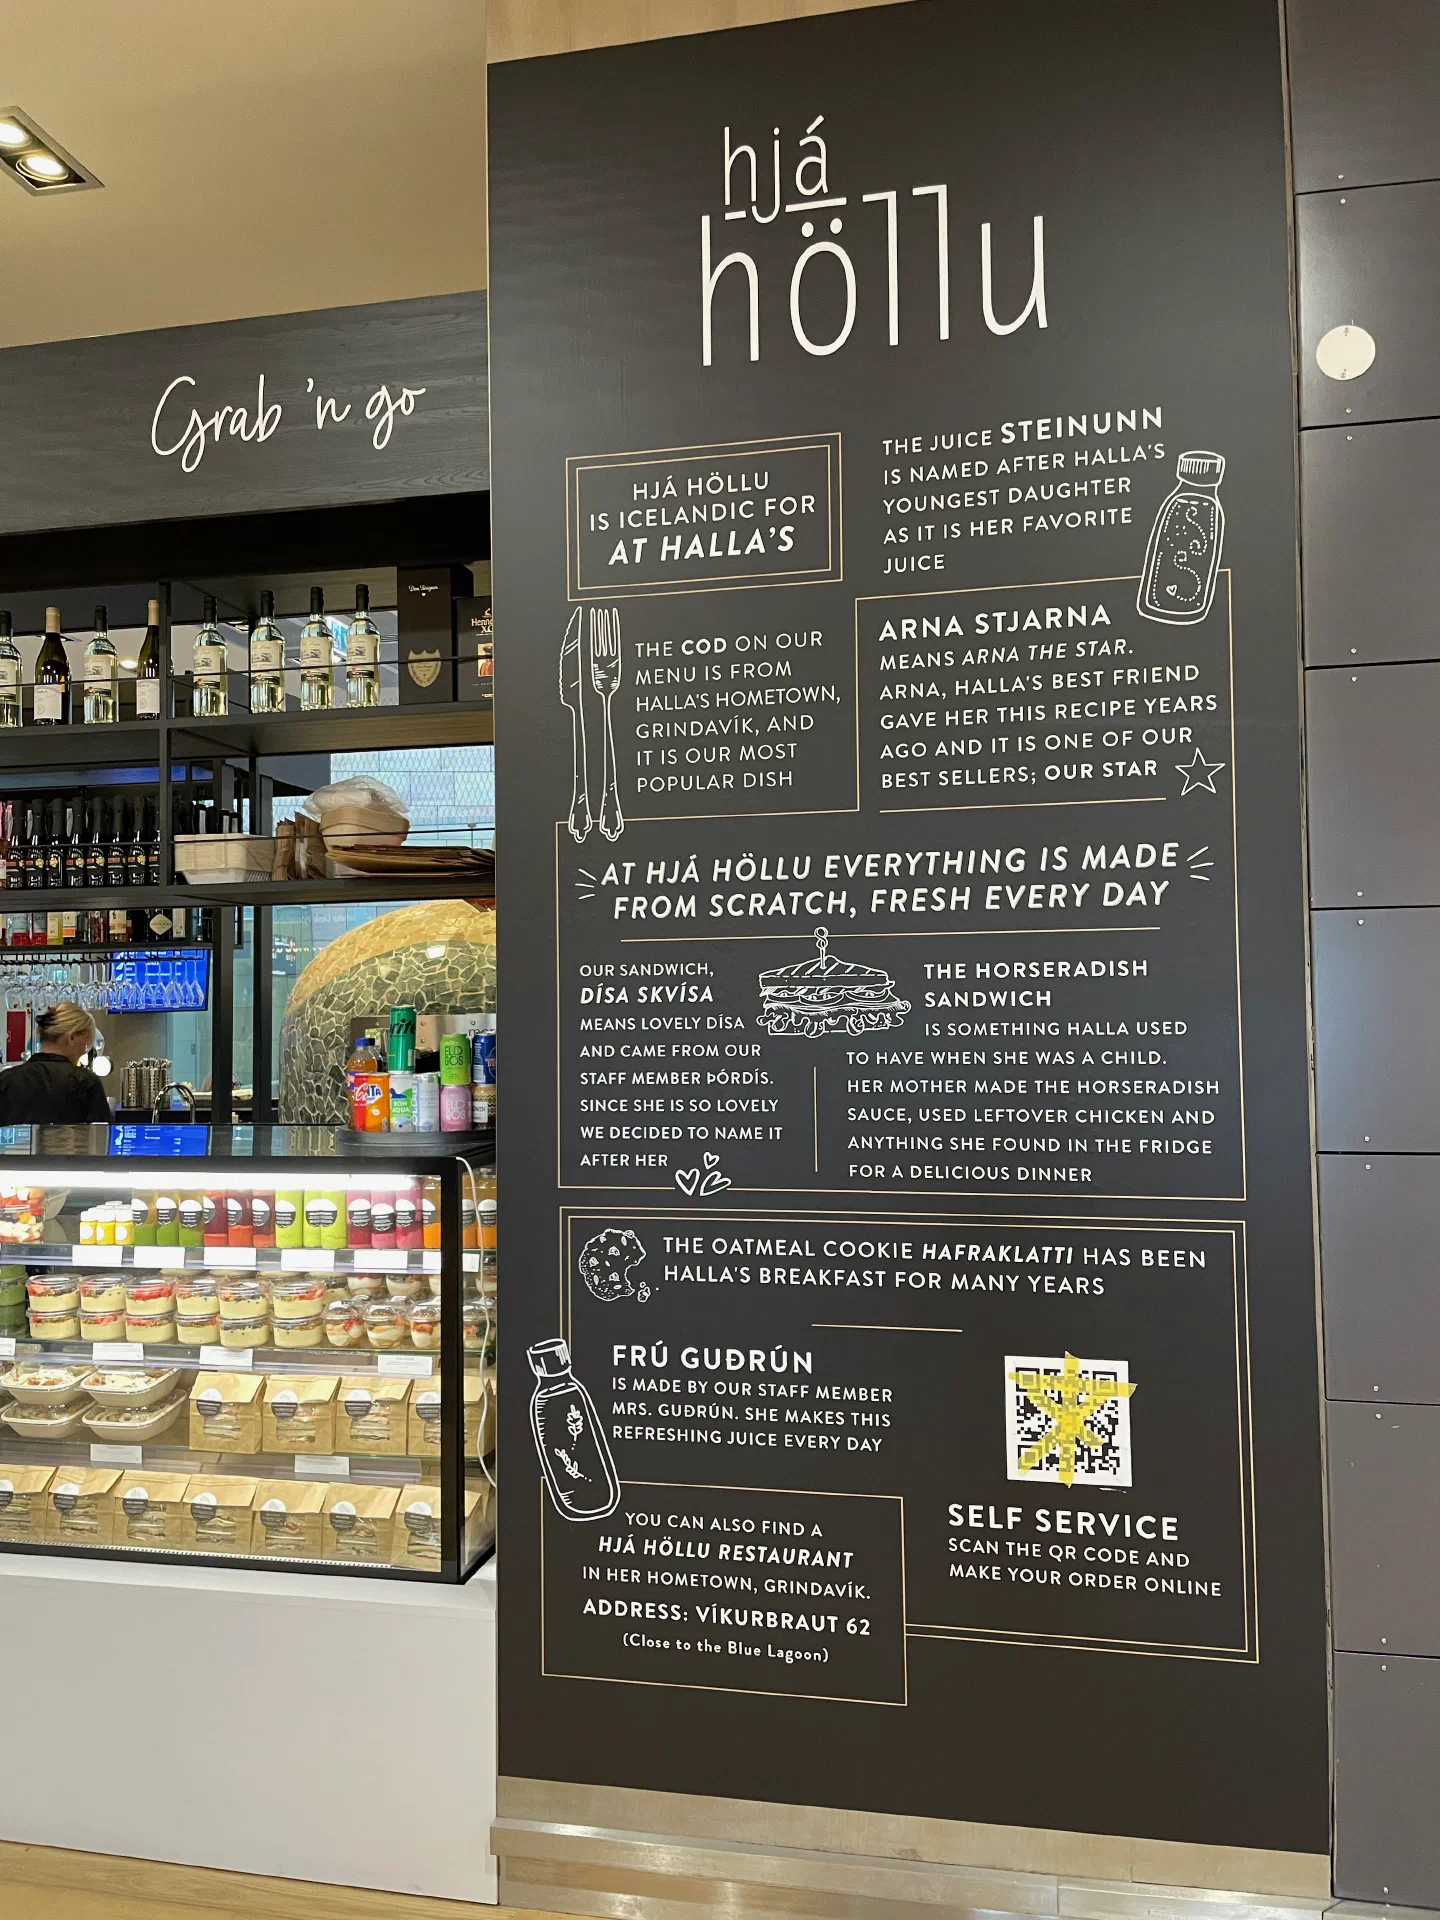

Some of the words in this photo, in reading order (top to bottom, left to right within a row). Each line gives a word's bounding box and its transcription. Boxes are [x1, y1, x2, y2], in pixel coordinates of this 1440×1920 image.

[724, 115, 829, 224] hjá
[701, 184, 1048, 367] höllu
[151, 373, 282, 473] Grab
[365, 385, 427, 450] go
[882, 436, 922, 456] THE
[929, 430, 992, 451] JUICE
[1001, 407, 1161, 444] STEINUNN
[884, 468, 901, 485] IS
[910, 460, 988, 483] NAMED
[996, 453, 1065, 475] AFTER
[1074, 443, 1165, 467] HALLA'S
[633, 475, 678, 501] HJÁ
[688, 471, 768, 497] HÖLLU
[883, 489, 1000, 515] YOUNGEST
[1009, 477, 1131, 503] DAUGHTER
[590, 513, 609, 531] IS
[620, 500, 754, 529] ICELANDIC
[765, 495, 815, 517] FOR
[608, 537, 648, 565] AT
[660, 525, 795, 561] HALLA'S
[883, 554, 944, 574] JUICE
[878, 615, 964, 641] ARNA
[975, 604, 1111, 634] STJARNA
[634, 641, 673, 658] THE
[681, 637, 727, 655] COD
[735, 635, 767, 652] ON
[776, 631, 822, 649] OUR
[880, 651, 955, 671] MEANS
[961, 646, 1019, 666] ARNA
[1028, 643, 1067, 661] THE
[1075, 639, 1133, 657] STAR.
[879, 682, 946, 700] ARNA,
[955, 674, 1043, 696] HALLA'S
[1052, 671, 1104, 689] BEST
[1113, 665, 1199, 686] FRIEND
[636, 693, 710, 712] HALLA'S
[716, 685, 840, 708] HOMETOWN,
[636, 714, 759, 739] GRINDAVÍK,
[766, 715, 814, 732] AND
[637, 774, 734, 793] POPULAR
[743, 771, 792, 788] DISH
[882, 771, 931, 788] BEST
[938, 766, 1036, 786] SELLERS;
[1044, 763, 1093, 780] OUR
[1102, 760, 1157, 778] STAR
[600, 862, 636, 886] AT
[646, 854, 700, 884] HJÁ
[712, 853, 811, 882] HÖLLU
[824, 848, 1026, 878] EVERYTHING
[1040, 846, 1068, 872] IS
[1081, 842, 1179, 870] MADE
[614, 894, 696, 919] FROM
[709, 890, 856, 919] SCRATCH,
[871, 886, 971, 913] FRESH
[985, 883, 1090, 910] EVERY
[1103, 880, 1169, 907] DAY
[579, 964, 615, 977] OUR
[619, 962, 714, 977] SANDWICH,
[924, 963, 966, 979] THE
[976, 960, 1147, 979] HORSERADISH
[580, 982, 629, 1004] DÍSA
[637, 981, 713, 1003] SKVÍSA
[925, 990, 1051, 1008] SANDWICH
[580, 1017, 636, 1031] MEANS
[641, 1016, 701, 1030] LOVELY
[706, 1014, 745, 1029] DÍSA
[925, 1023, 941, 1036] IS
[947, 1022, 1060, 1036] SOMETHING
[1068, 1022, 1129, 1036] HALLA
[1136, 1021, 1187, 1035] USED
[579, 1045, 615, 1057] AND
[620, 1044, 667, 1057] CAME
[672, 1044, 719, 1057] FROM
[724, 1044, 761, 1057] OUR
[580, 1072, 627, 1085] STAFF
[631, 1071, 701, 1085] MEMBER
[706, 1068, 774, 1085] ÞÓRDÍS.
[848, 1079, 883, 1093] HER
[890, 1079, 967, 1093] MOTHER
[974, 1079, 1028, 1094] MADE
[1033, 1079, 1070, 1094] THE
[1077, 1080, 1219, 1095] HORSERADISH
[848, 1107, 912, 1125] SAUCE,
[918, 1107, 967, 1122] USED
[974, 1108, 1068, 1123] LEFTOVER
[1075, 1109, 1164, 1124] CHICKEN
[1171, 1109, 1215, 1124] AND
[580, 1153, 630, 1166] AFTER
[635, 1154, 668, 1167] HER
[663, 1237, 704, 1254] THE
[712, 1238, 816, 1256] OATMEAL
[823, 1240, 913, 1259] COOKIE
[922, 1243, 1073, 1264] HAFRAKLATTI
[1083, 1247, 1131, 1266] HAS
[1141, 1249, 1205, 1268] BEEN
[665, 1265, 751, 1283] HALLA'S
[759, 1267, 886, 1287] BREAKFAST
[895, 1271, 941, 1289] FOR
[951, 1273, 1020, 1292] MANY
[1027, 1275, 1104, 1295] YEARS
[613, 1340, 668, 1368] FRÚ
[680, 1344, 812, 1374] GUÐRÚN
[612, 1377, 626, 1391] IS
[632, 1378, 681, 1393] MADE
[688, 1380, 708, 1394] BY
[714, 1381, 752, 1396] OUR
[758, 1383, 809, 1399] STAFF
[815, 1385, 892, 1402] MEMBER
[612, 1401, 652, 1416] MRS.
[658, 1402, 739, 1420] GUÐRÚN.
[745, 1406, 778, 1422] SHE
[785, 1409, 845, 1426] MAKES
[850, 1412, 891, 1427] THIS
[948, 1503, 1022, 1530] SELF
[1035, 1509, 1178, 1541] SERVICE
[598, 1533, 636, 1554] HJÁ
[643, 1535, 710, 1559] HÖLLU
[718, 1544, 854, 1568] RESTAURANT
[583, 1566, 600, 1580] IN
[607, 1568, 641, 1583] HER
[647, 1570, 758, 1594] HOMETOWN,
[764, 1578, 871, 1599] GRINDAVÍK.
[949, 1563, 1001, 1580] MAKE
[1007, 1567, 1061, 1585] YOUR
[1068, 1572, 1136, 1590] ORDER
[1144, 1577, 1221, 1596] ONLINE
[583, 1598, 688, 1622] ADDRESS:
[695, 1603, 838, 1633] VÍKURBRAUT
[846, 1617, 870, 1636] 62
[623, 1632, 670, 1649] (Close
[676, 1639, 691, 1651] to
[696, 1638, 721, 1653] the
[728, 1640, 761, 1656] Blue
[768, 1644, 828, 1664] Lagoon)
